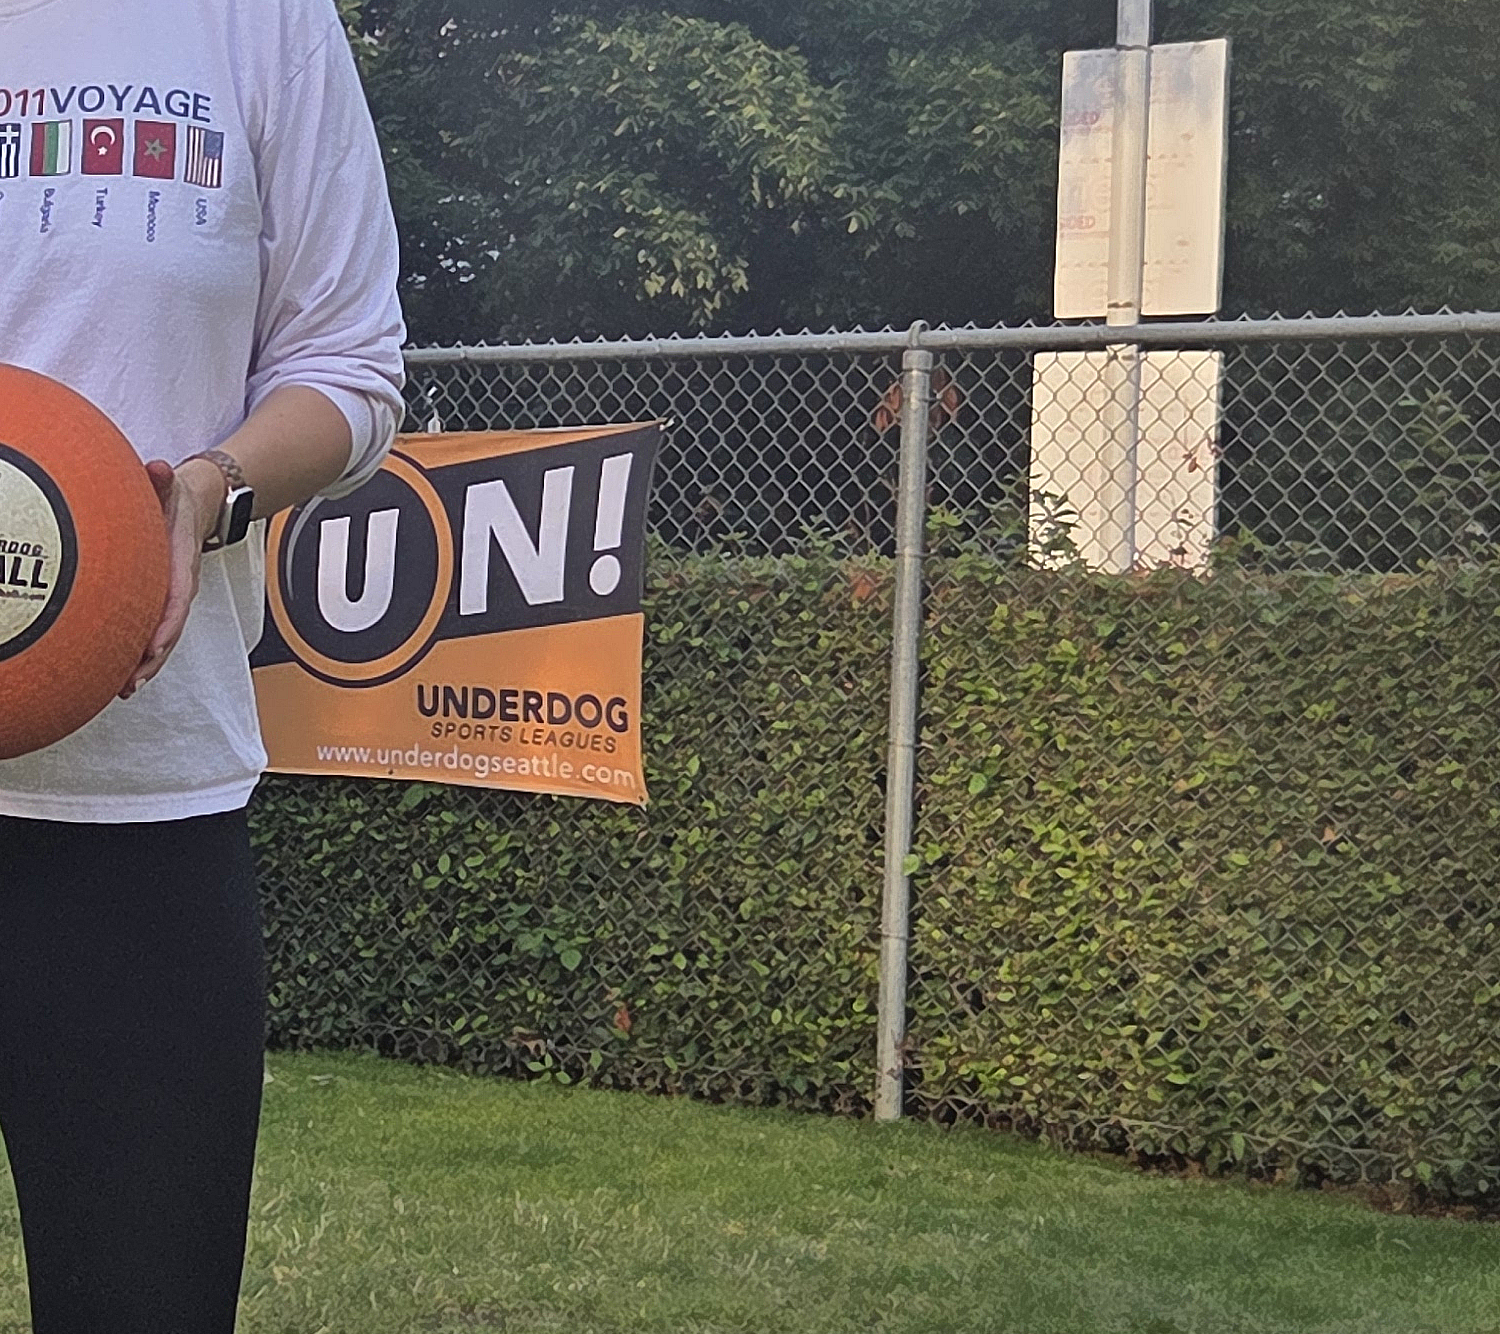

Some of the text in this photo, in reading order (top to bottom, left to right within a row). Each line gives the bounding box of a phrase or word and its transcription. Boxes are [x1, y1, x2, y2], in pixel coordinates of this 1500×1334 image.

[195, 198, 208, 226] USA
[416, 684, 630, 733] UNDERDOG
[430, 721, 617, 754] SPORTS LEAGUES
[316, 742, 636, 789] www.underdogseattle.com
